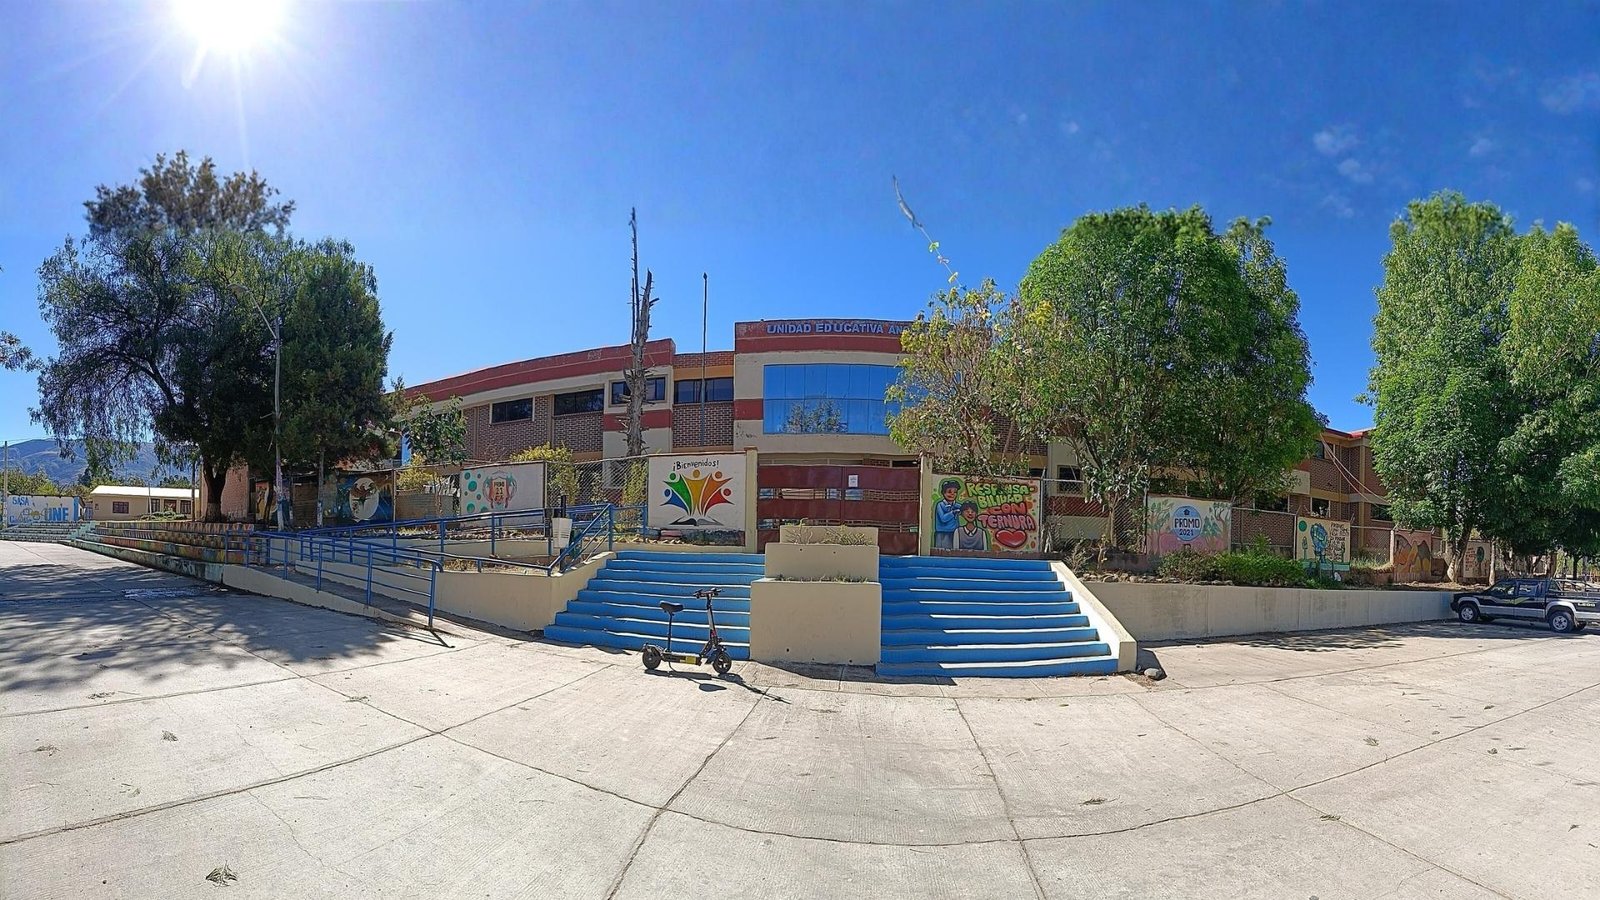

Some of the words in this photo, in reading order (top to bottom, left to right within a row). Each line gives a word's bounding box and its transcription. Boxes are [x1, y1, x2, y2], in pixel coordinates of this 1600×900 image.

[766, 324, 811, 334] UNIDAD
[815, 323, 884, 334] EDUCATIVA
[672, 458, 719, 471] ¡Bienvenidos!
[977, 514, 1036, 531] TERNURA
[1174, 518, 1200, 528] PROMO
